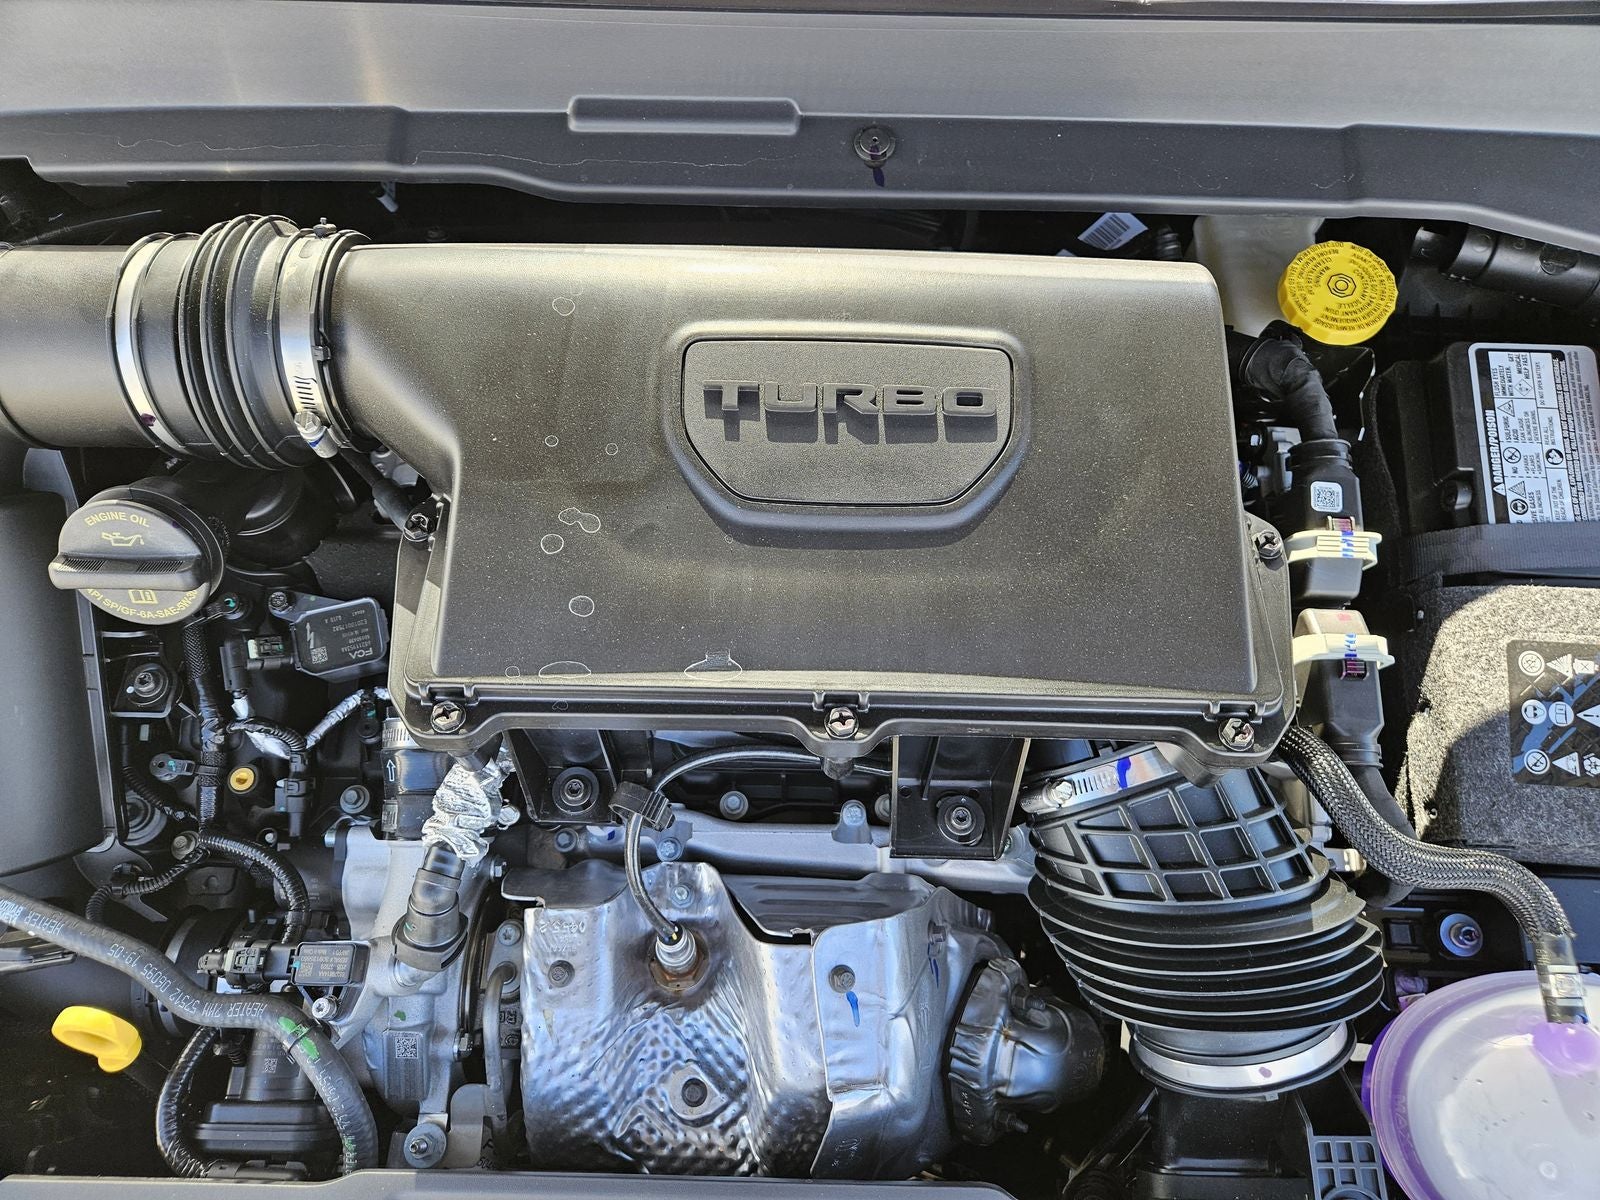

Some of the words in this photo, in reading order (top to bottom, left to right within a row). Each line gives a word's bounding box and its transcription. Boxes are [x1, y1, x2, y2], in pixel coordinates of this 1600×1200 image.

[1514, 353, 1522, 374] MEDICAL
[1498, 364, 1507, 396] IMMEDIATELY
[702, 380, 997, 418] TURBO
[1502, 415, 1511, 440] SULFURIC
[1569, 431, 1577, 449] FOLLOW
[1484, 409, 1504, 483] DANGER/POISON
[1528, 491, 1536, 508] GASES
[1577, 491, 1587, 520] COMMENDED
[84, 511, 127, 526] ENGINE
[129, 514, 150, 528] OIL
[348, 647, 373, 659] FCA
[24, 910, 64, 936] HEATER
[107, 943, 140, 968] 19:05
[140, 963, 172, 993] 06095
[168, 987, 200, 1014] 57512
[201, 1002, 222, 1018] 7MM
[226, 1002, 268, 1018] HEATER
